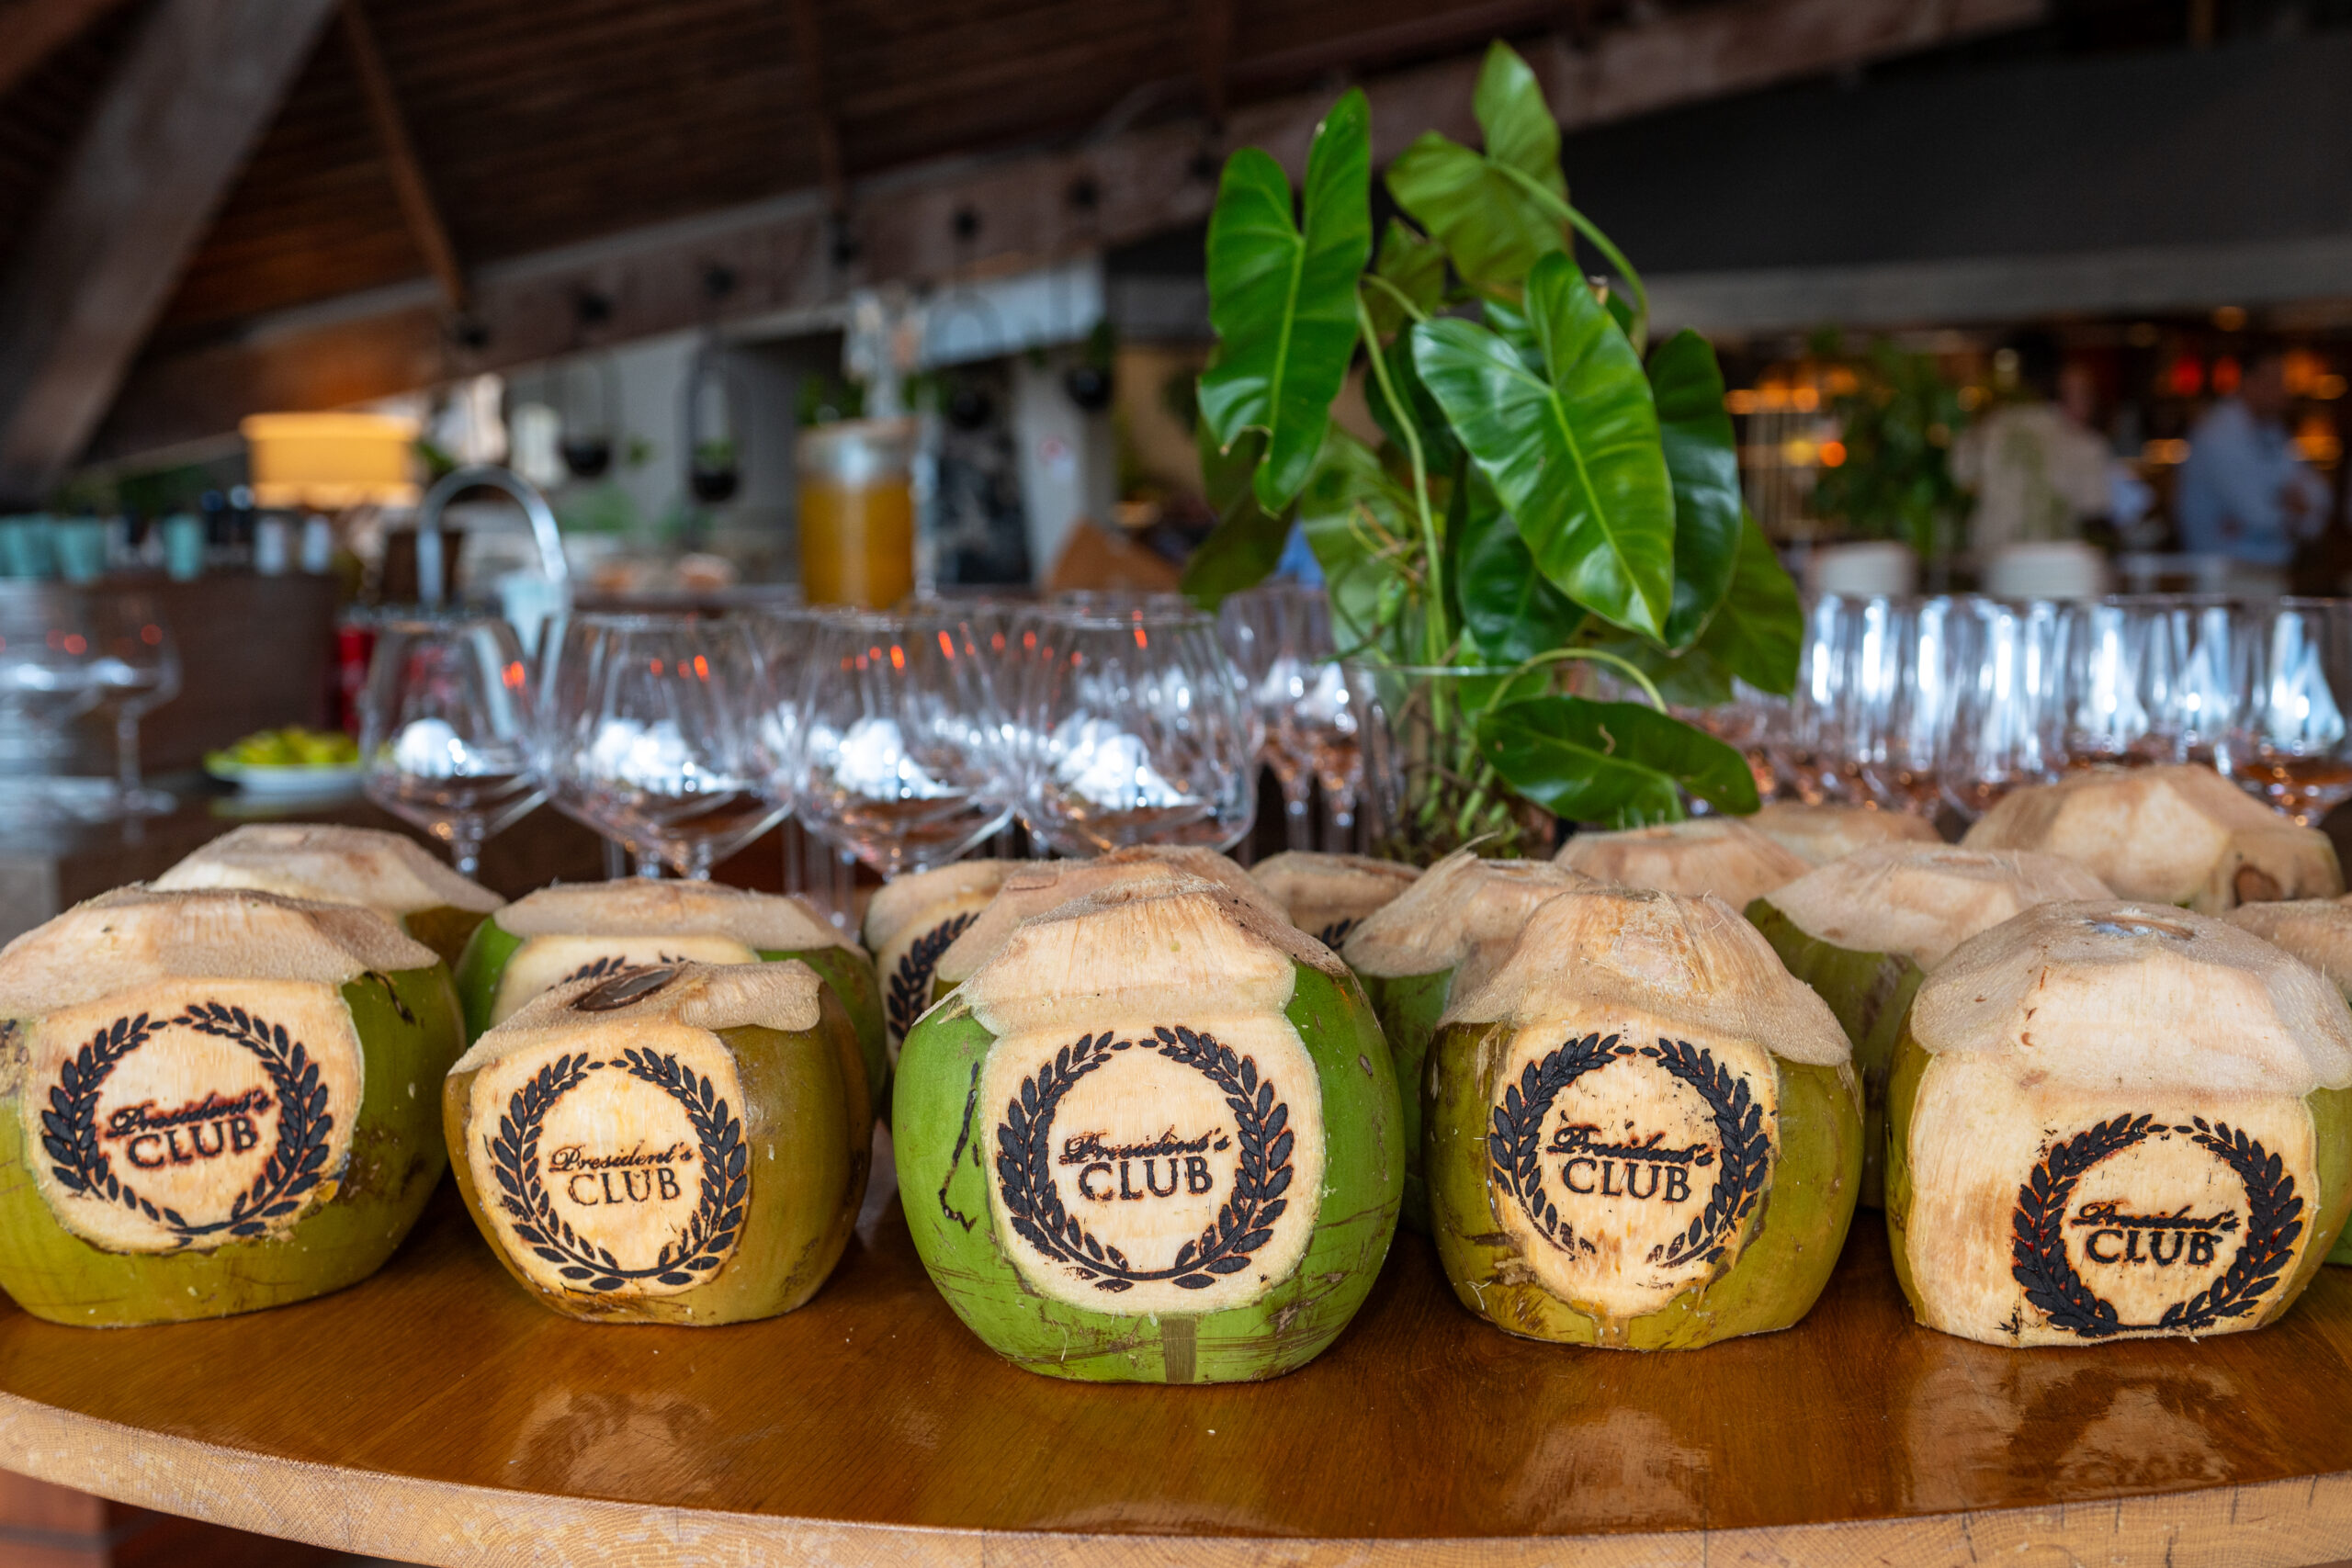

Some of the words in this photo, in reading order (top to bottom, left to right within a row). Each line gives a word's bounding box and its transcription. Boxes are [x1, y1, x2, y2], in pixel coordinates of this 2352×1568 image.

[128, 1116, 259, 1168] CLUB
[548, 1142, 694, 1172] President's
[568, 1168, 682, 1206] CLUB
[1078, 1156, 1213, 1201] CLUB
[1562, 1157, 1692, 1203] CLUB
[2086, 1229, 2216, 1266] CLUB
